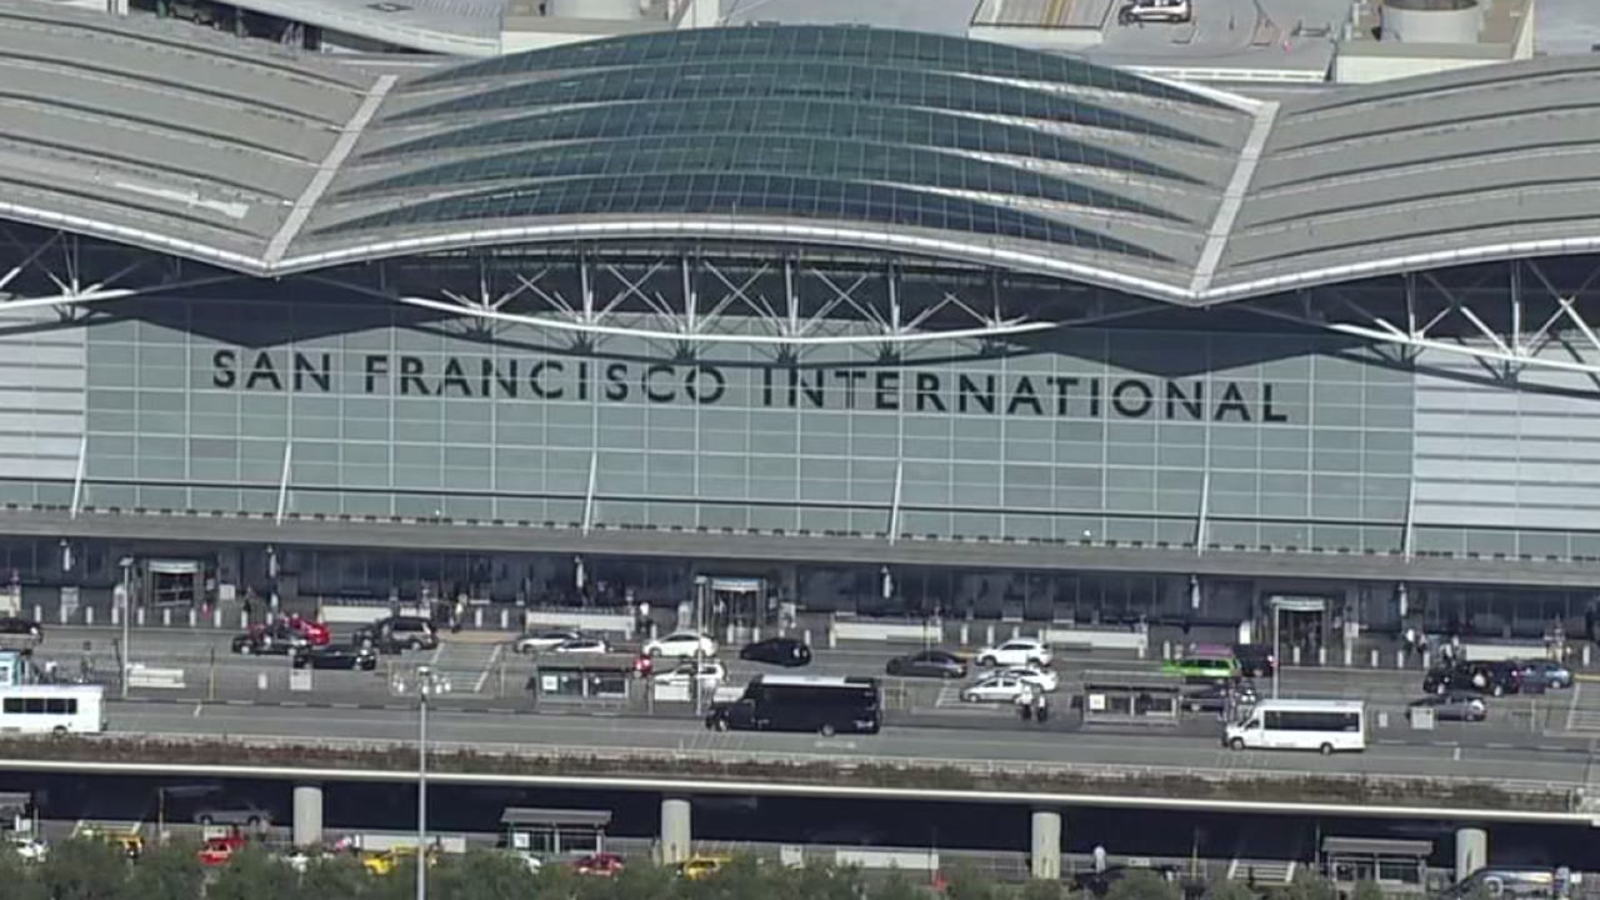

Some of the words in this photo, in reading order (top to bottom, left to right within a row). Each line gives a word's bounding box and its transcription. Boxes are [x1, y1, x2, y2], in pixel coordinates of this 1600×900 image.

[213, 350, 330, 391] SAN
[365, 355, 725, 404] FRANCISCO
[764, 367, 1288, 422] INTERNATIONAL
